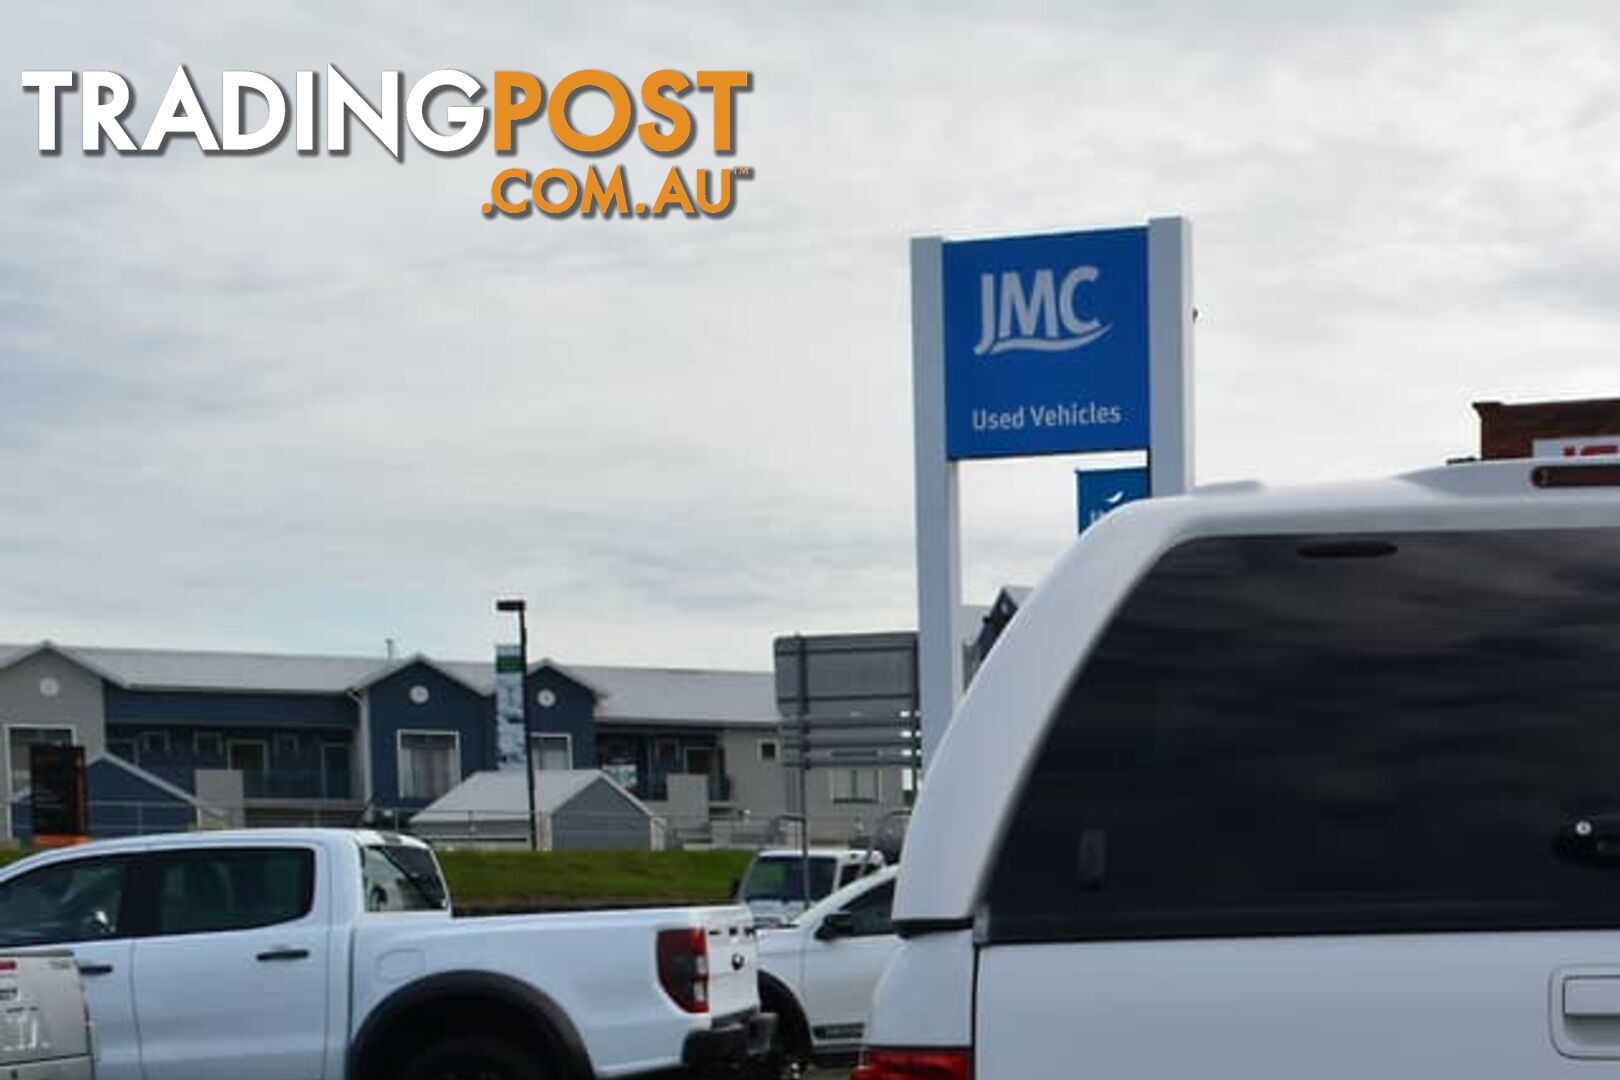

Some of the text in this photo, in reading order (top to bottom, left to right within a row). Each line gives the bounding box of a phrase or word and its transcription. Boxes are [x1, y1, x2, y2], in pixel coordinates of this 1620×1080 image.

[973, 266, 1101, 355] JMC
[972, 402, 1121, 431] Used Vehicles
